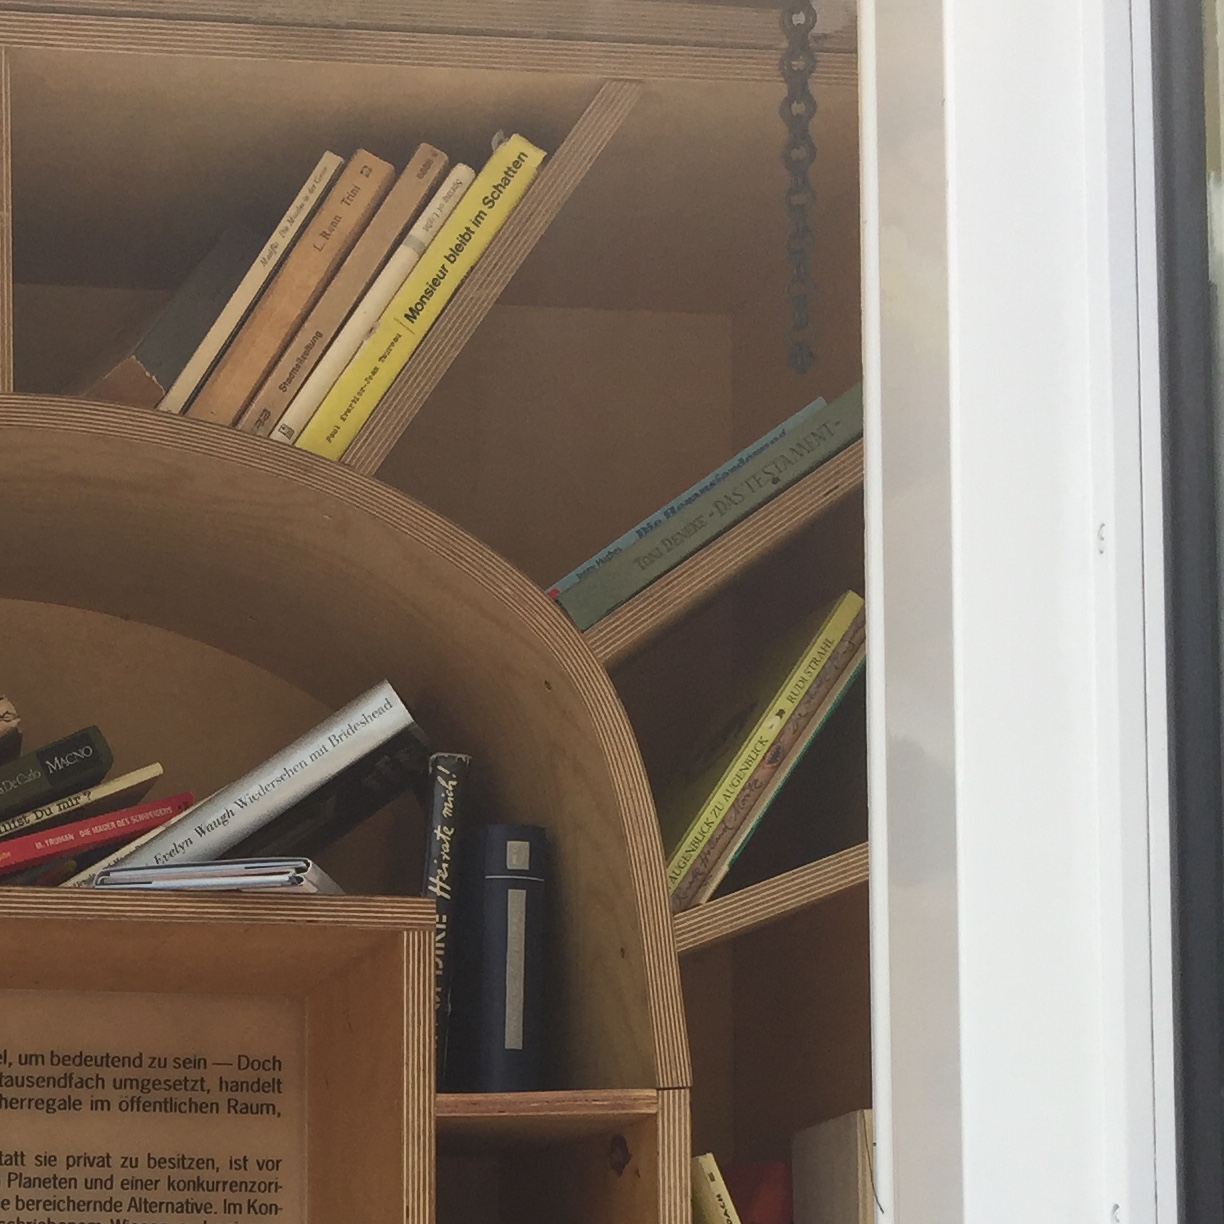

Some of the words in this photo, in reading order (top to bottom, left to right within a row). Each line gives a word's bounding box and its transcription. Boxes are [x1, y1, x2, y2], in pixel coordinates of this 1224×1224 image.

[318, 212, 342, 241] Renn
[339, 182, 361, 209] Trini
[402, 261, 450, 324] Monsieur
[442, 224, 476, 266] bleibt
[468, 208, 488, 228] im
[479, 148, 529, 211] Schatten
[710, 486, 746, 517] DAS
[741, 421, 836, 495] TESTAMENT
[152, 834, 195, 870] Evelyn
[193, 804, 237, 842] Waugh
[234, 755, 309, 812] Wiedersehen
[306, 742, 329, 763] mit
[326, 695, 394, 748] Brideshead
[664, 816, 714, 884] AUGENBLICK
[709, 800, 726, 818] ZU
[719, 735, 769, 802] AUGENBLICK
[785, 674, 810, 704] RUDI
[803, 635, 836, 678] STRAHL
[31, 804, 53, 821] Du
[433, 764, 458, 817] mich!
[427, 825, 455, 900] Heirate
[17, 1051, 46, 1067] um
[49, 1048, 144, 1068] bedeutend
[147, 1053, 168, 1069] zu
[172, 1050, 208, 1070] sein
[236, 1051, 283, 1071] Doch
[111, 1072, 211, 1096] umgesetzt,
[218, 1074, 284, 1094] handelt
[89, 1093, 112, 1113] im
[117, 1094, 221, 1114] öffentlichen
[226, 1096, 282, 1120] Raum,
[6, 1171, 78, 1191] Planeten
[83, 1172, 115, 1192] und
[119, 1172, 162, 1192] einer
[166, 1174, 284, 1194] konkurrenzori-
